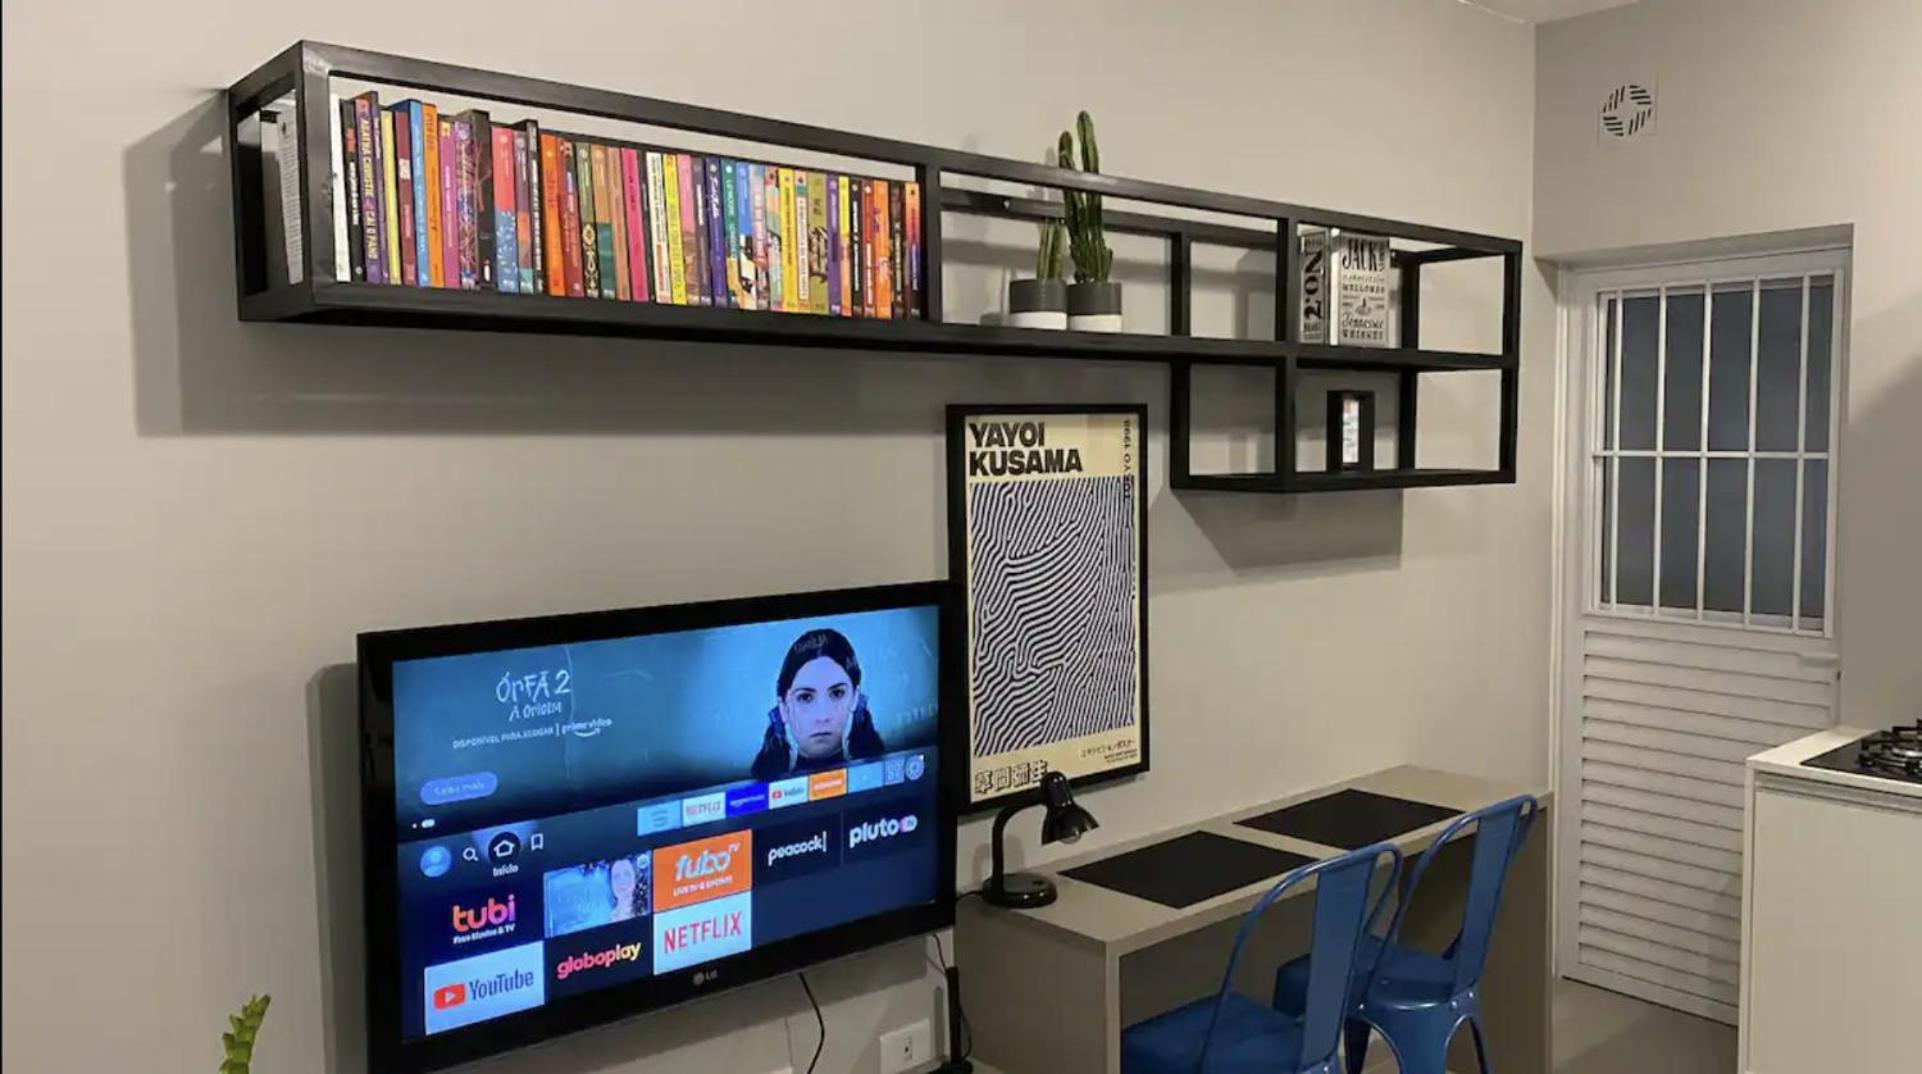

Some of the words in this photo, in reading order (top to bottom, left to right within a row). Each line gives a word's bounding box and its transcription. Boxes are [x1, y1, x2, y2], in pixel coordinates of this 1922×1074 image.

[1342, 238, 1377, 272] JACK
[968, 422, 1045, 448] YAYOI
[1123, 419, 1131, 448] 1998
[969, 449, 1083, 476] KUSAMA
[554, 670, 571, 694] 2
[849, 817, 900, 848] pluto
[768, 835, 822, 865] peacock
[493, 864, 519, 877] Início
[452, 894, 516, 932] tubi
[664, 912, 742, 954] NETFLIX
[557, 942, 642, 980] globoplay
[469, 970, 534, 1000] YouTube
